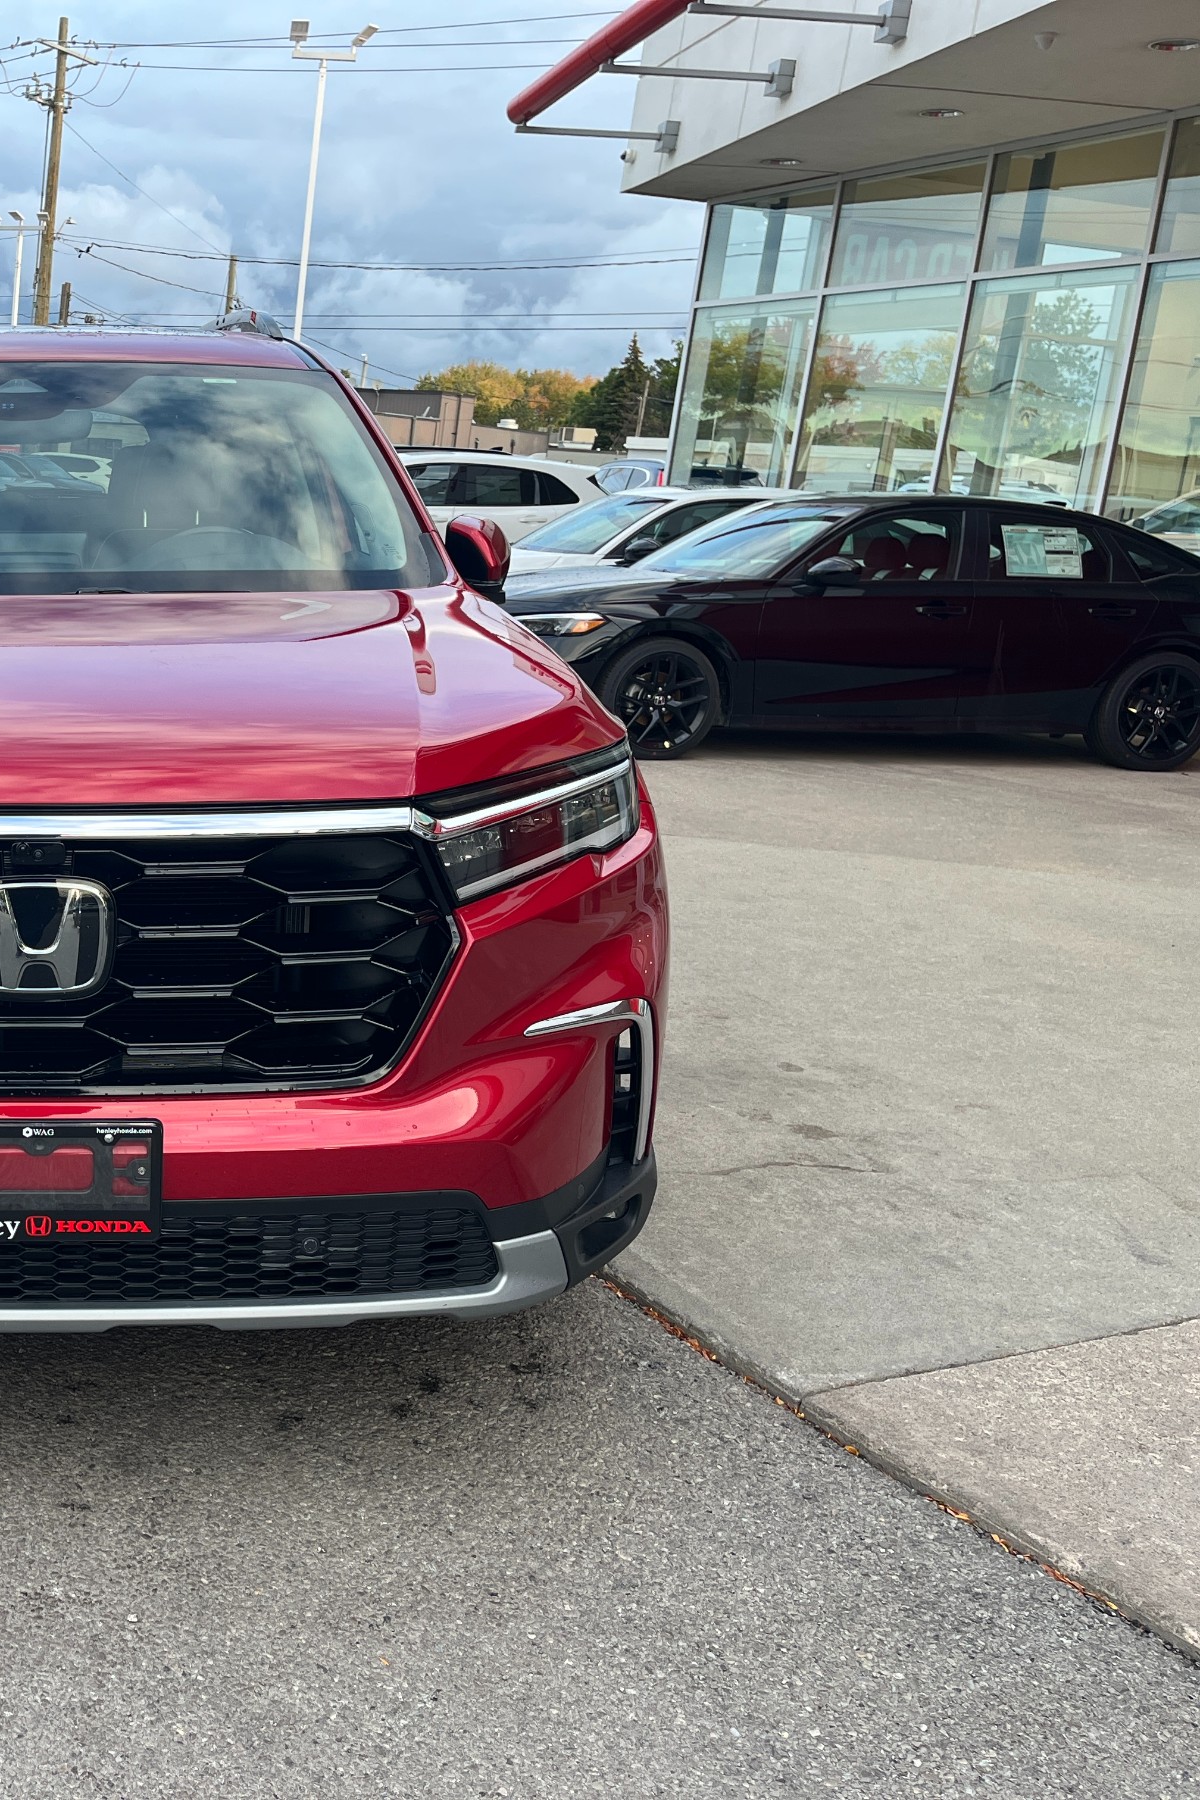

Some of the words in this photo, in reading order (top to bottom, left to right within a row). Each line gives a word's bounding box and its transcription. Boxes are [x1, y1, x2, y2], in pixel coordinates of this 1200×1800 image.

[33, 1128, 55, 1136] WAG
[96, 1127, 153, 1135] henleyhonda.com
[56, 1220, 152, 1233] HONDA
